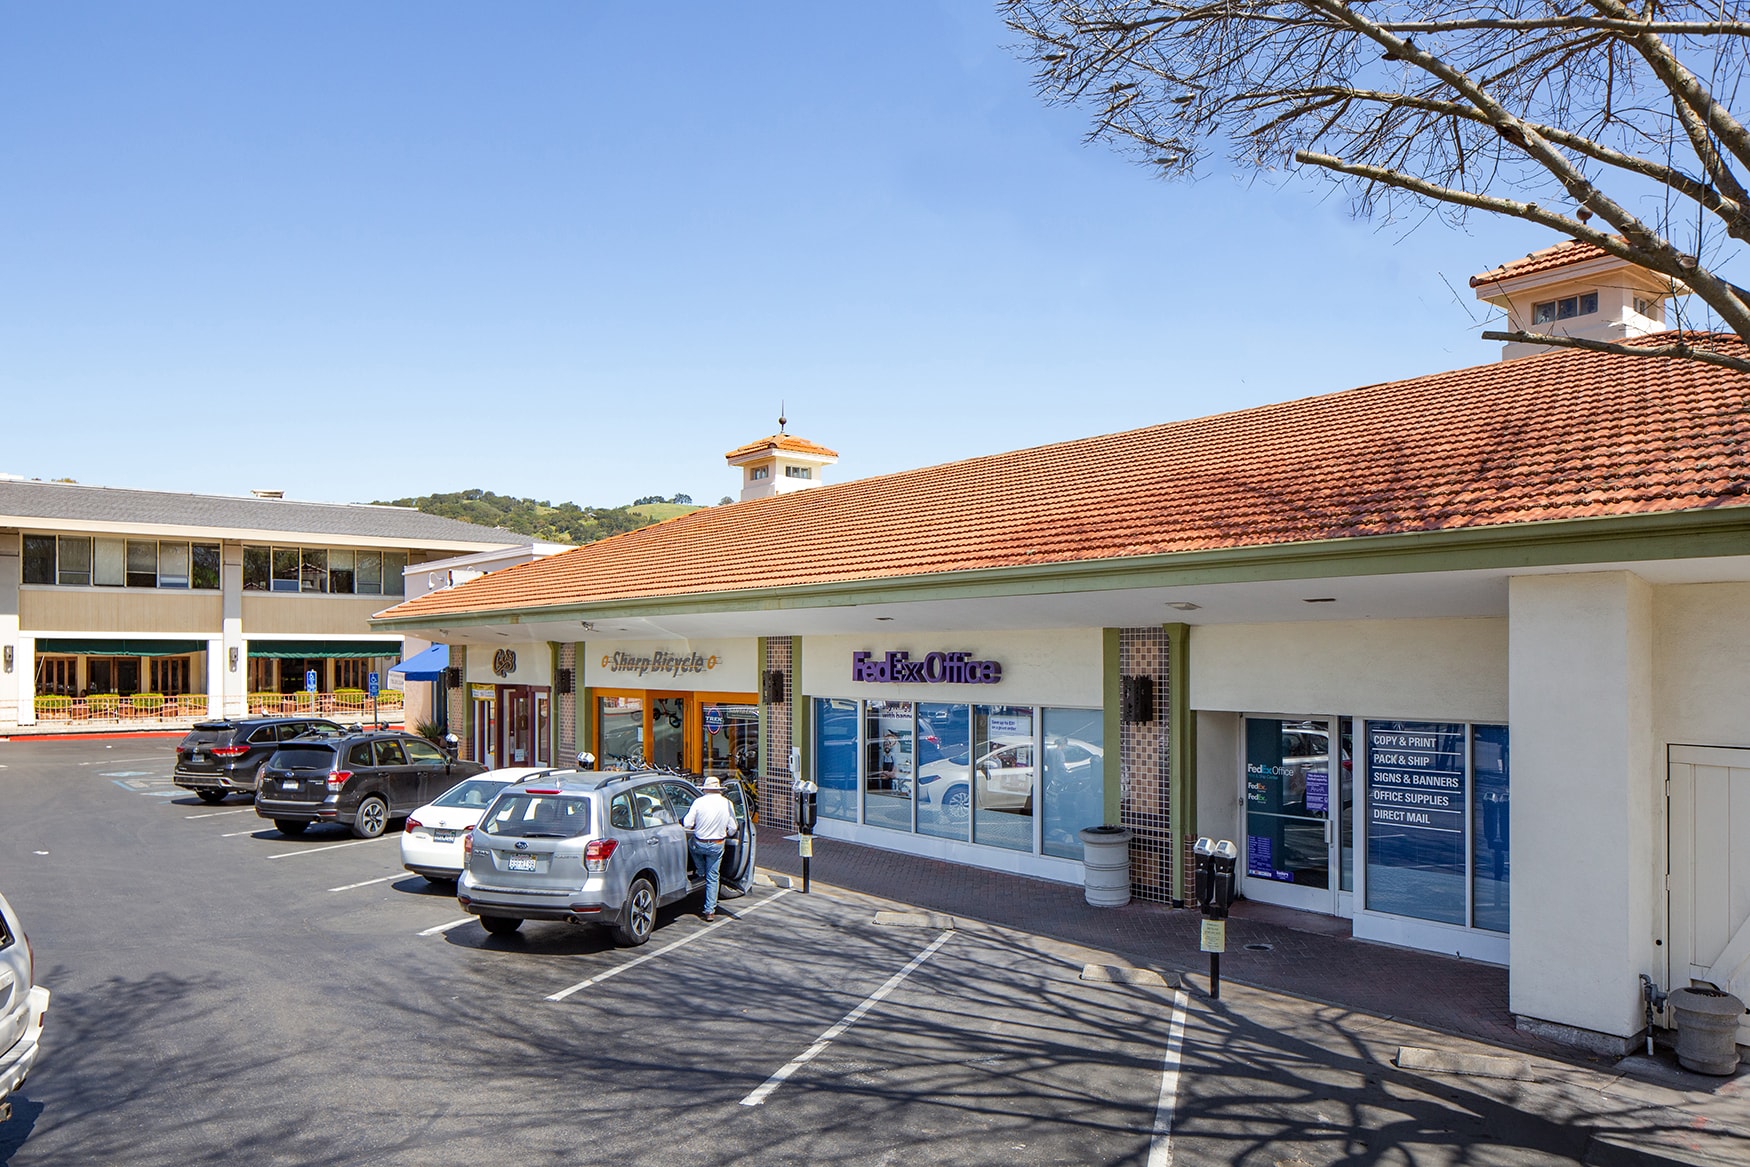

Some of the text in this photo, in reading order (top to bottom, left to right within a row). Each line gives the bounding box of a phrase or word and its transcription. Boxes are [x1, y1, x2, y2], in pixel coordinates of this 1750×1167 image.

[611, 651, 704, 678] Sharp Bicycle
[853, 651, 1002, 684] FedEx Office
[1373, 735, 1436, 748] COPY & PRINT
[1373, 754, 1430, 766] PACK & SHIP
[1247, 763, 1294, 777] FedEx Office
[1247, 782, 1266, 790] FedEx
[1373, 772, 1459, 788] SIGNS & BANNERS
[1247, 793, 1266, 801] FedEx
[1373, 790, 1449, 806] OFFICE SUPPLIES
[1373, 809, 1431, 824] DIRECT MAIL
